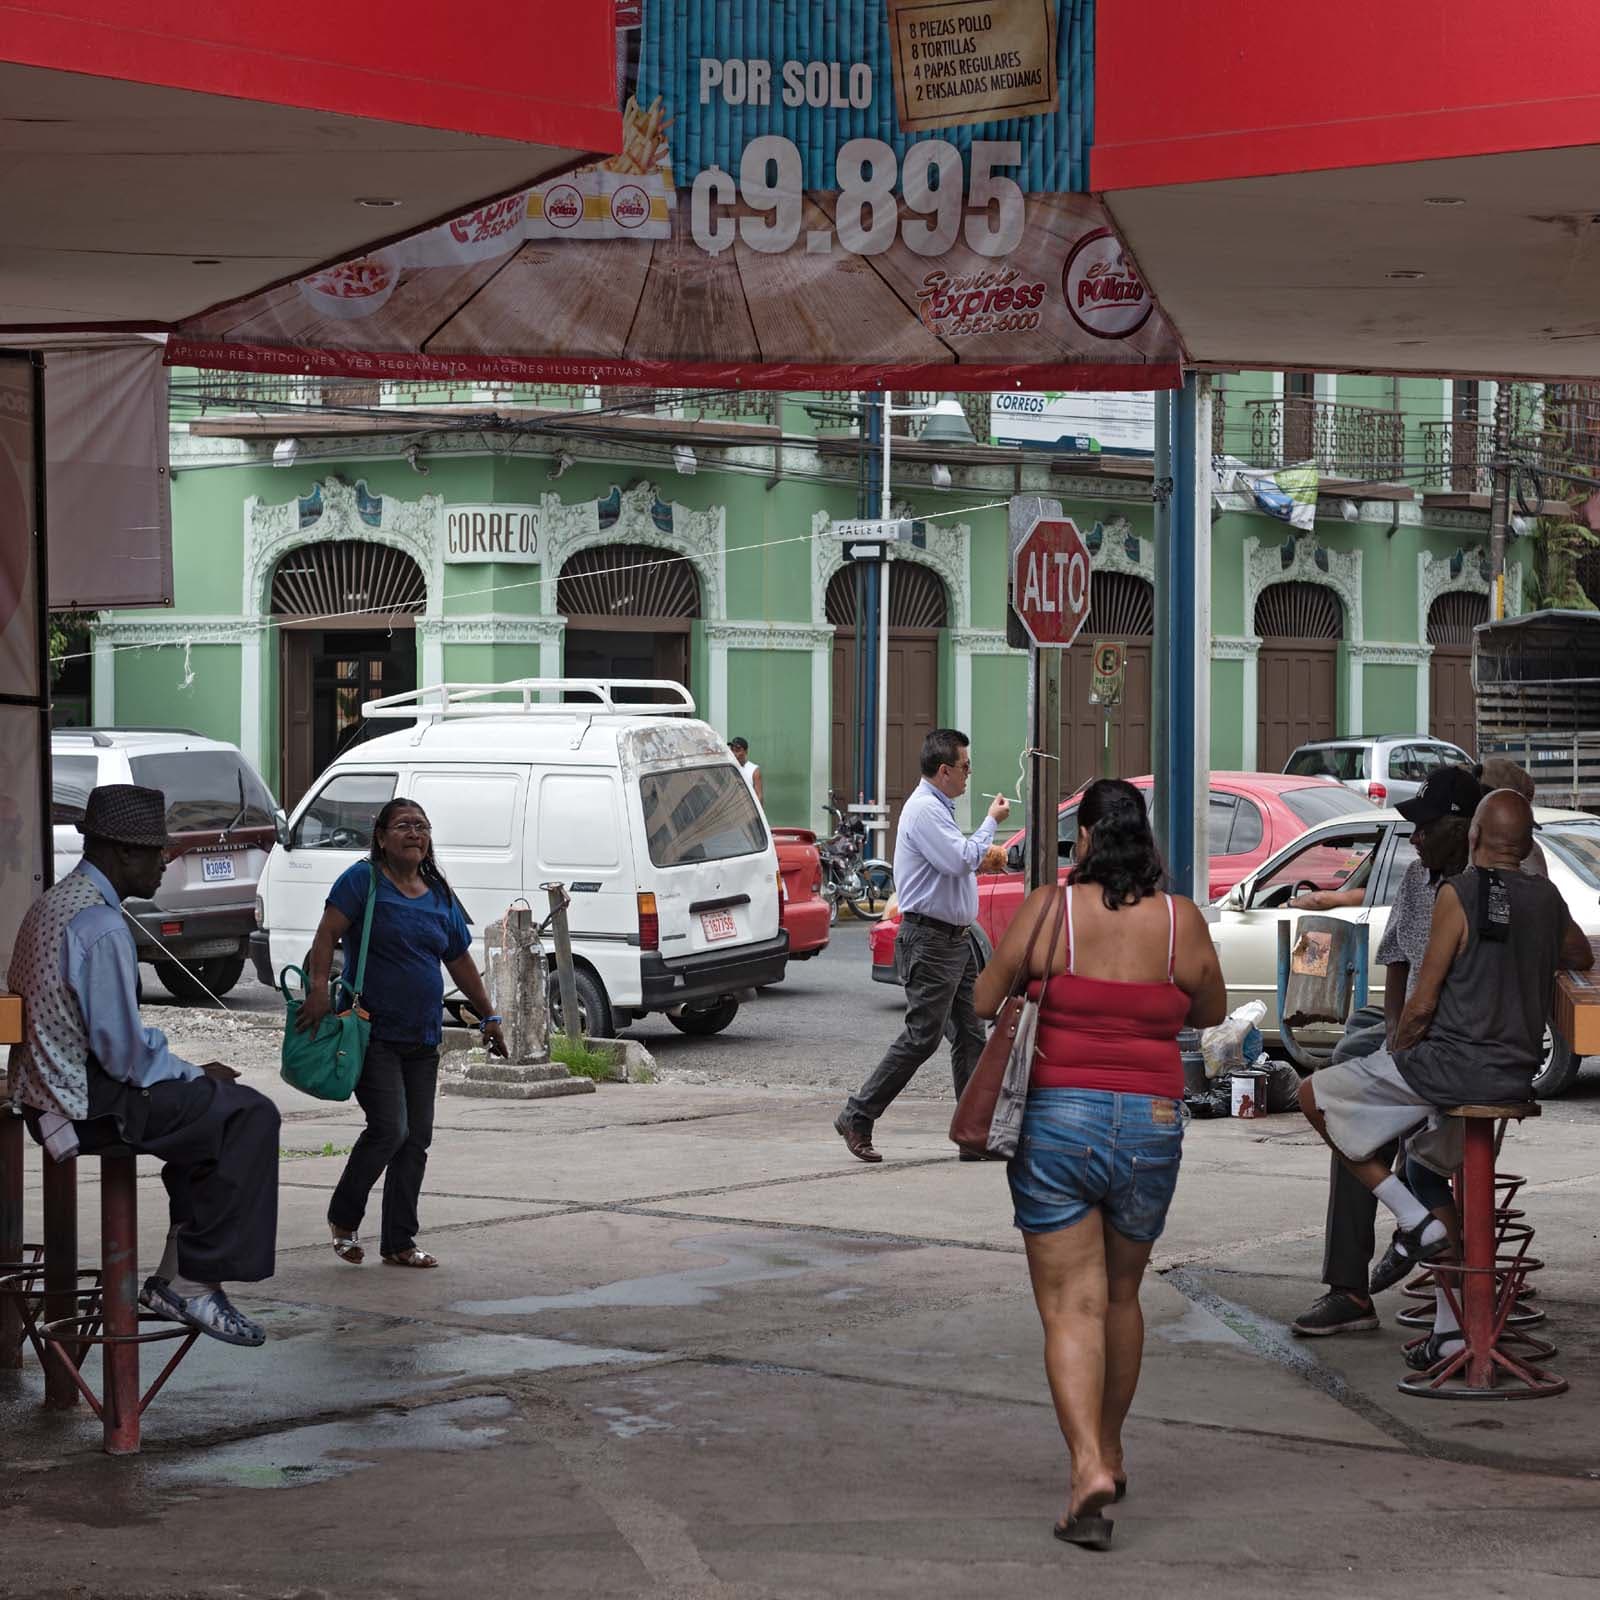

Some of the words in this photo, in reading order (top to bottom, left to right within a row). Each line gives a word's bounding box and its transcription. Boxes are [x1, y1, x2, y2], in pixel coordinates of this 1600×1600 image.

[909, 23, 917, 39] 8
[920, 18, 956, 38] PIEZAS
[958, 14, 992, 33] POLLO
[911, 43, 919, 60] 8
[921, 37, 976, 58] TORTILLAS
[913, 64, 920, 80] 4
[924, 60, 957, 80] PAPAS
[959, 50, 1022, 75] REGULARES
[700, 58, 771, 105] POR
[782, 60, 873, 109] SOLO
[916, 85, 924, 101] 2
[926, 76, 988, 100] ENSALADAS
[990, 68, 1042, 91] MEDIANAS
[916, 266, 1020, 297] Servicio
[929, 284, 1045, 321] Express
[949, 312, 1039, 336] 2552-6000
[347, 358, 372, 368] VER
[996, 393, 1044, 413] CORREOS
[448, 512, 538, 554] CORREOS
[838, 525, 872, 535] CALLE
[876, 525, 882, 534] 4
[1023, 552, 1086, 613] ALTO
[206, 861, 232, 876] 830958
